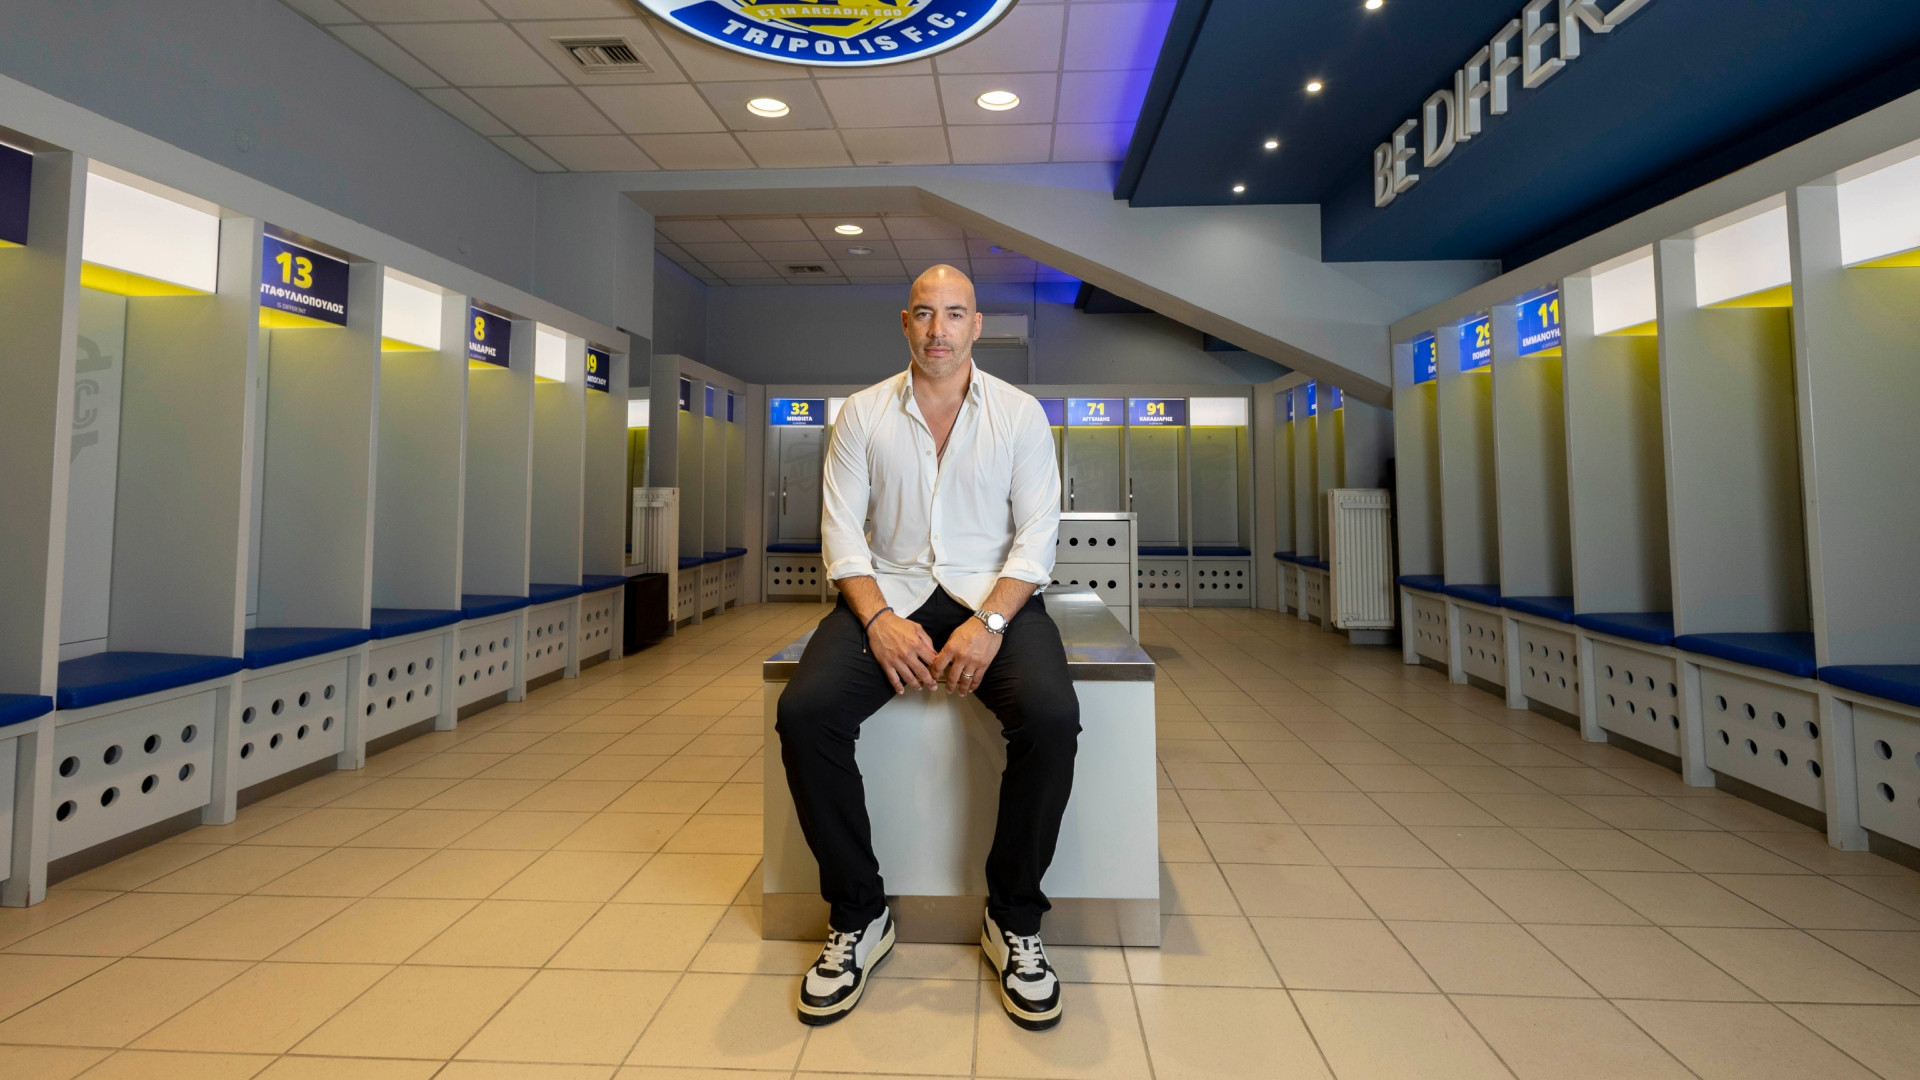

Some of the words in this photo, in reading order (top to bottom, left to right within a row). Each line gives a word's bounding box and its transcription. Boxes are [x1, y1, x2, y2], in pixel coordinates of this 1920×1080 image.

[758, 8, 776, 18] ET
[781, 7, 797, 16] IN
[804, 7, 869, 17] ARCADIA
[873, 9, 902, 17] EGO
[722, 19, 899, 55] TRIPOLIS
[899, 10, 968, 43] F.C.
[1374, 119, 1419, 208] BE
[1423, 0, 1651, 167] DIFFER
[275, 251, 313, 289] 13
[1538, 299, 1559, 328] 11
[474, 316, 485, 341] 8
[1522, 327, 1561, 347] ΕΜΜΑΝΟΥΗ
[791, 402, 809, 415] 32
[1087, 402, 1105, 415] 71
[1146, 402, 1165, 415] 91
